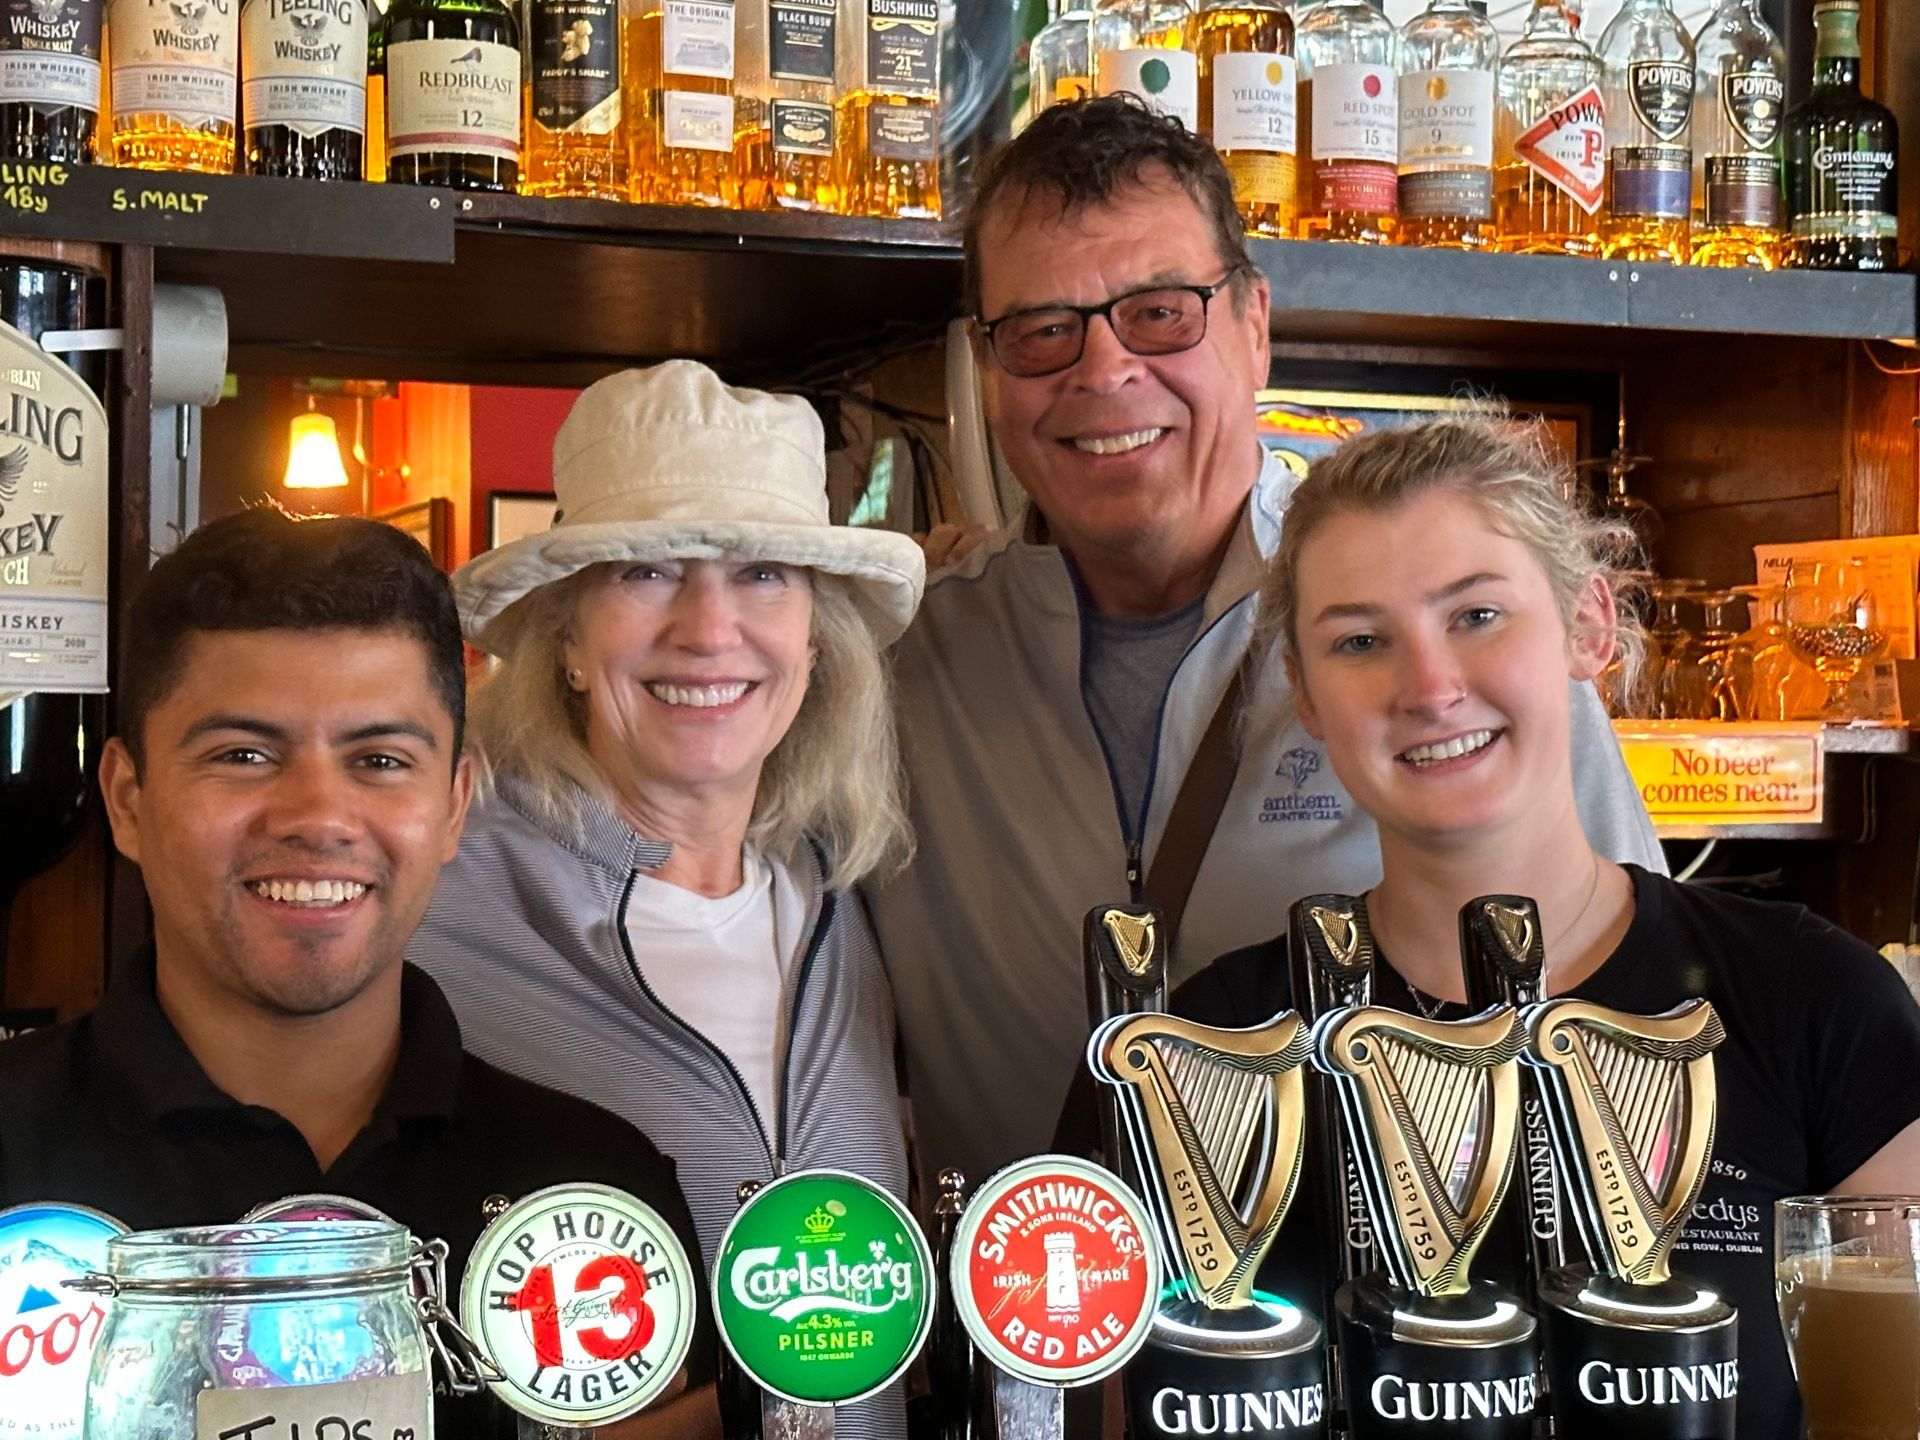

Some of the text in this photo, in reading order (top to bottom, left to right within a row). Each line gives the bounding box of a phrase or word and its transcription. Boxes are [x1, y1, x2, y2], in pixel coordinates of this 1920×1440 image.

[669, 4, 730, 20] THE ORIGINAL
[778, 11, 831, 27] BLACK BUSH
[871, 0, 937, 18] BUSHMILLS
[10, 16, 81, 39] WHISKEY
[52, 39, 73, 54] MALT
[153, 29, 219, 51] WHISKEY
[274, 41, 341, 61] WHISKEY
[5, 62, 87, 76] IRISH WHISKEY
[894, 54, 912, 71] 21
[147, 74, 225, 88] IRISH WHISKEY
[419, 71, 514, 95] REDBREAST
[1638, 66, 1693, 90] POWERS
[1732, 77, 1784, 101] POWERS
[268, 84, 349, 98] IRISH WHISKEY
[1231, 88, 1282, 102] YELLOW
[461, 109, 484, 128] 12
[1343, 102, 1395, 119] RED SPOT
[1403, 105, 1475, 121] GOLD SPOT
[1268, 116, 1282, 135] 12
[1431, 128, 1442, 145] 9
[1364, 129, 1380, 146] 15
[1579, 128, 1603, 169] P
[2, 163, 69, 186] LING
[1712, 164, 1724, 176] 12
[4, 184, 49, 214] 18y
[0, 368, 41, 392] UBLIN
[0, 391, 84, 469] ING
[64, 638, 87, 648] 2020
[1670, 748, 1776, 776] No beer
[1642, 782, 1800, 803] comes near.
[1258, 809, 1344, 823] COUNTRY CLUB
[1524, 1099, 1557, 1240] GUINNESS
[1028, 1212, 1055, 1231] SONS
[1056, 1211, 1098, 1234] IRELAND
[1607, 1195, 1639, 1249] 1759
[1687, 1197, 1760, 1231] edys
[1185, 1216, 1219, 1272] 1759
[1405, 1207, 1438, 1261] 1759
[1680, 1228, 1760, 1242] ESTAURANT
[1692, 1242, 1724, 1252] ROW,
[1725, 1243, 1763, 1254] DUBLIN
[488, 1210, 671, 1313] HOP HOUSE
[731, 1245, 913, 1311] Carlsberg
[993, 1273, 1033, 1288] IRISH
[503, 1254, 656, 1368] 13
[808, 1313, 843, 1329] 4.3%
[0, 1300, 106, 1378] oor
[778, 1330, 875, 1351] PILSNER
[1002, 1316, 1065, 1361] RED
[1076, 1312, 1125, 1358] ALE
[292, 1361, 336, 1383] ALE
[526, 1350, 655, 1403] LAGER
[1579, 1359, 1739, 1405] GUINNES
[1371, 1372, 1536, 1421] GUINNES
[1152, 1383, 1323, 1434] GUINNES
[25, 1423, 41, 1432] AS
